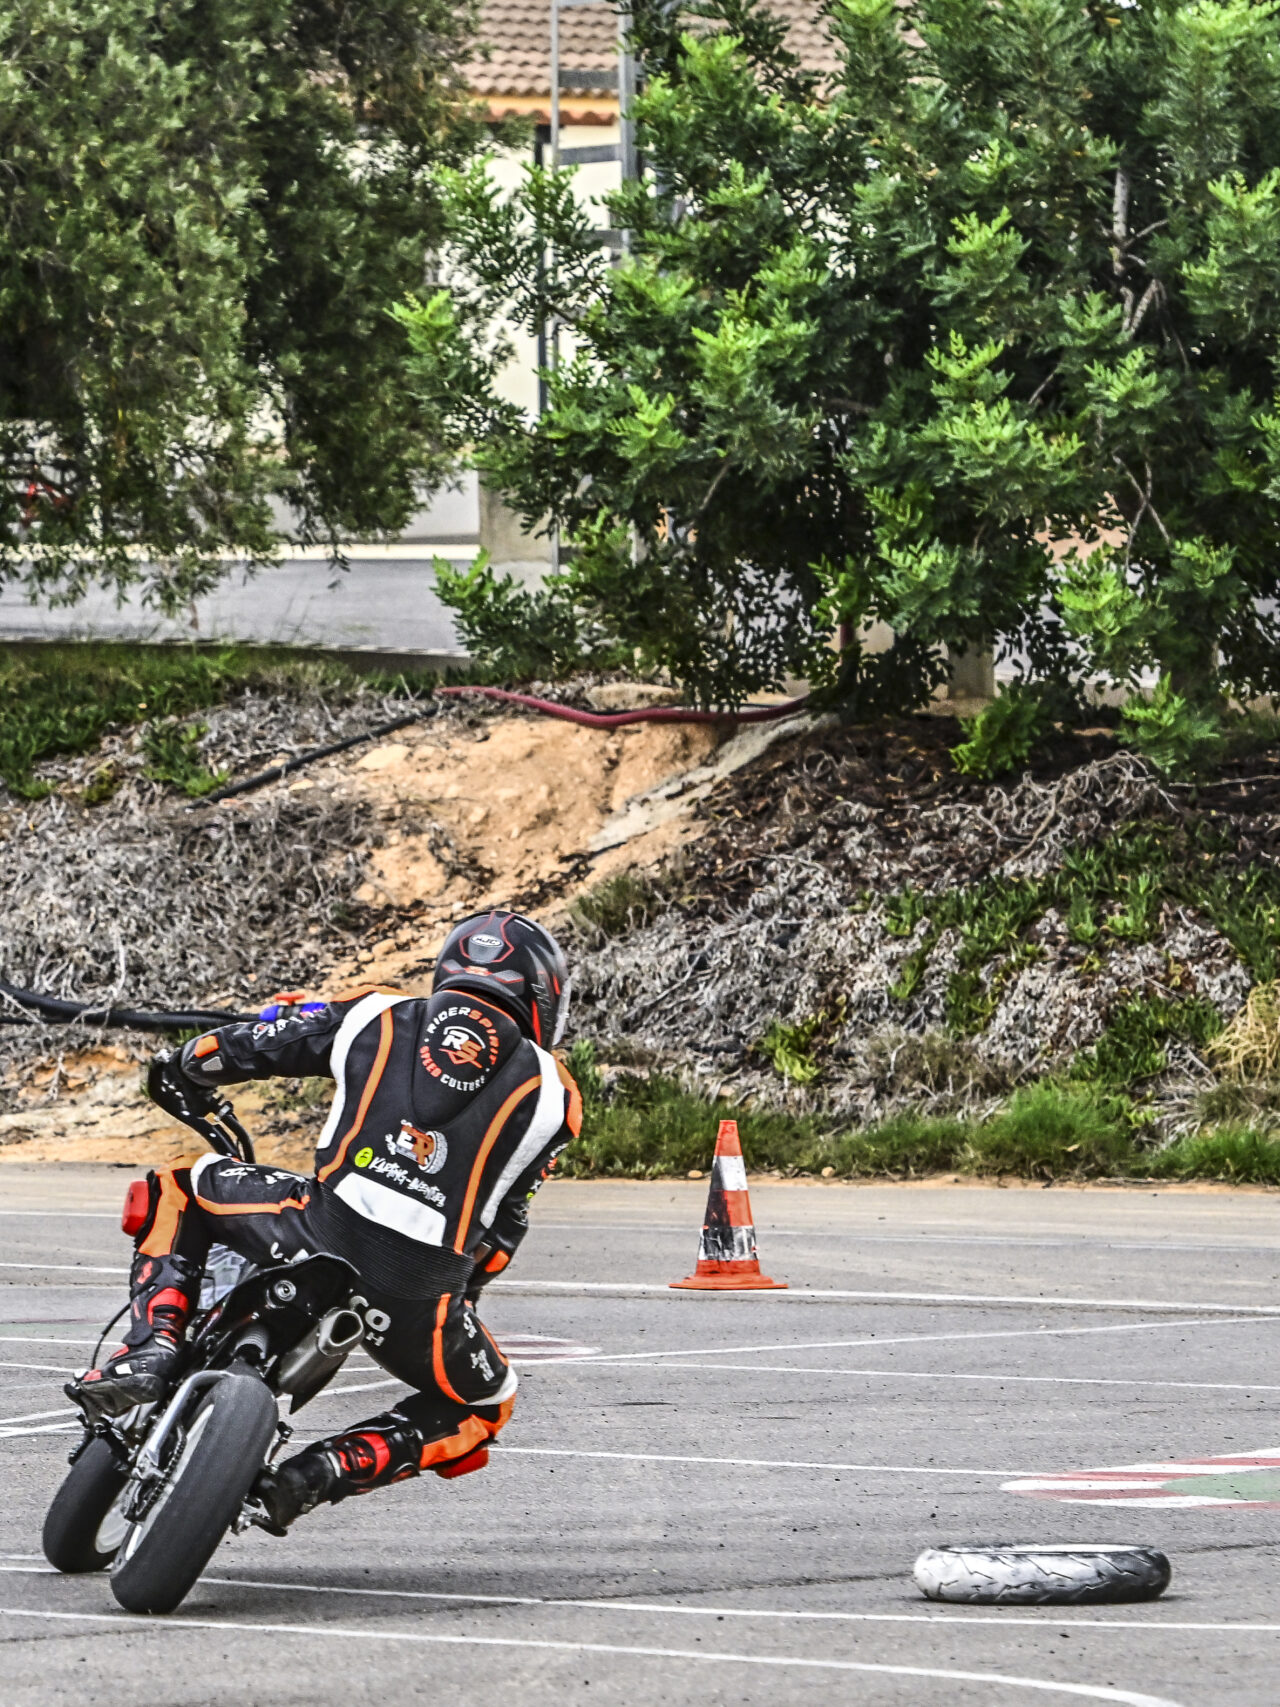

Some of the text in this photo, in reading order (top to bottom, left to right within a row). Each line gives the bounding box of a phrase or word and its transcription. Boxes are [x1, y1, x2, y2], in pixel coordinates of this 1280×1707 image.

[426, 1006, 500, 1066] RIDERSPIRIT
[441, 1029, 483, 1061] RS
[419, 1045, 485, 1092] SPEED CULTURE
